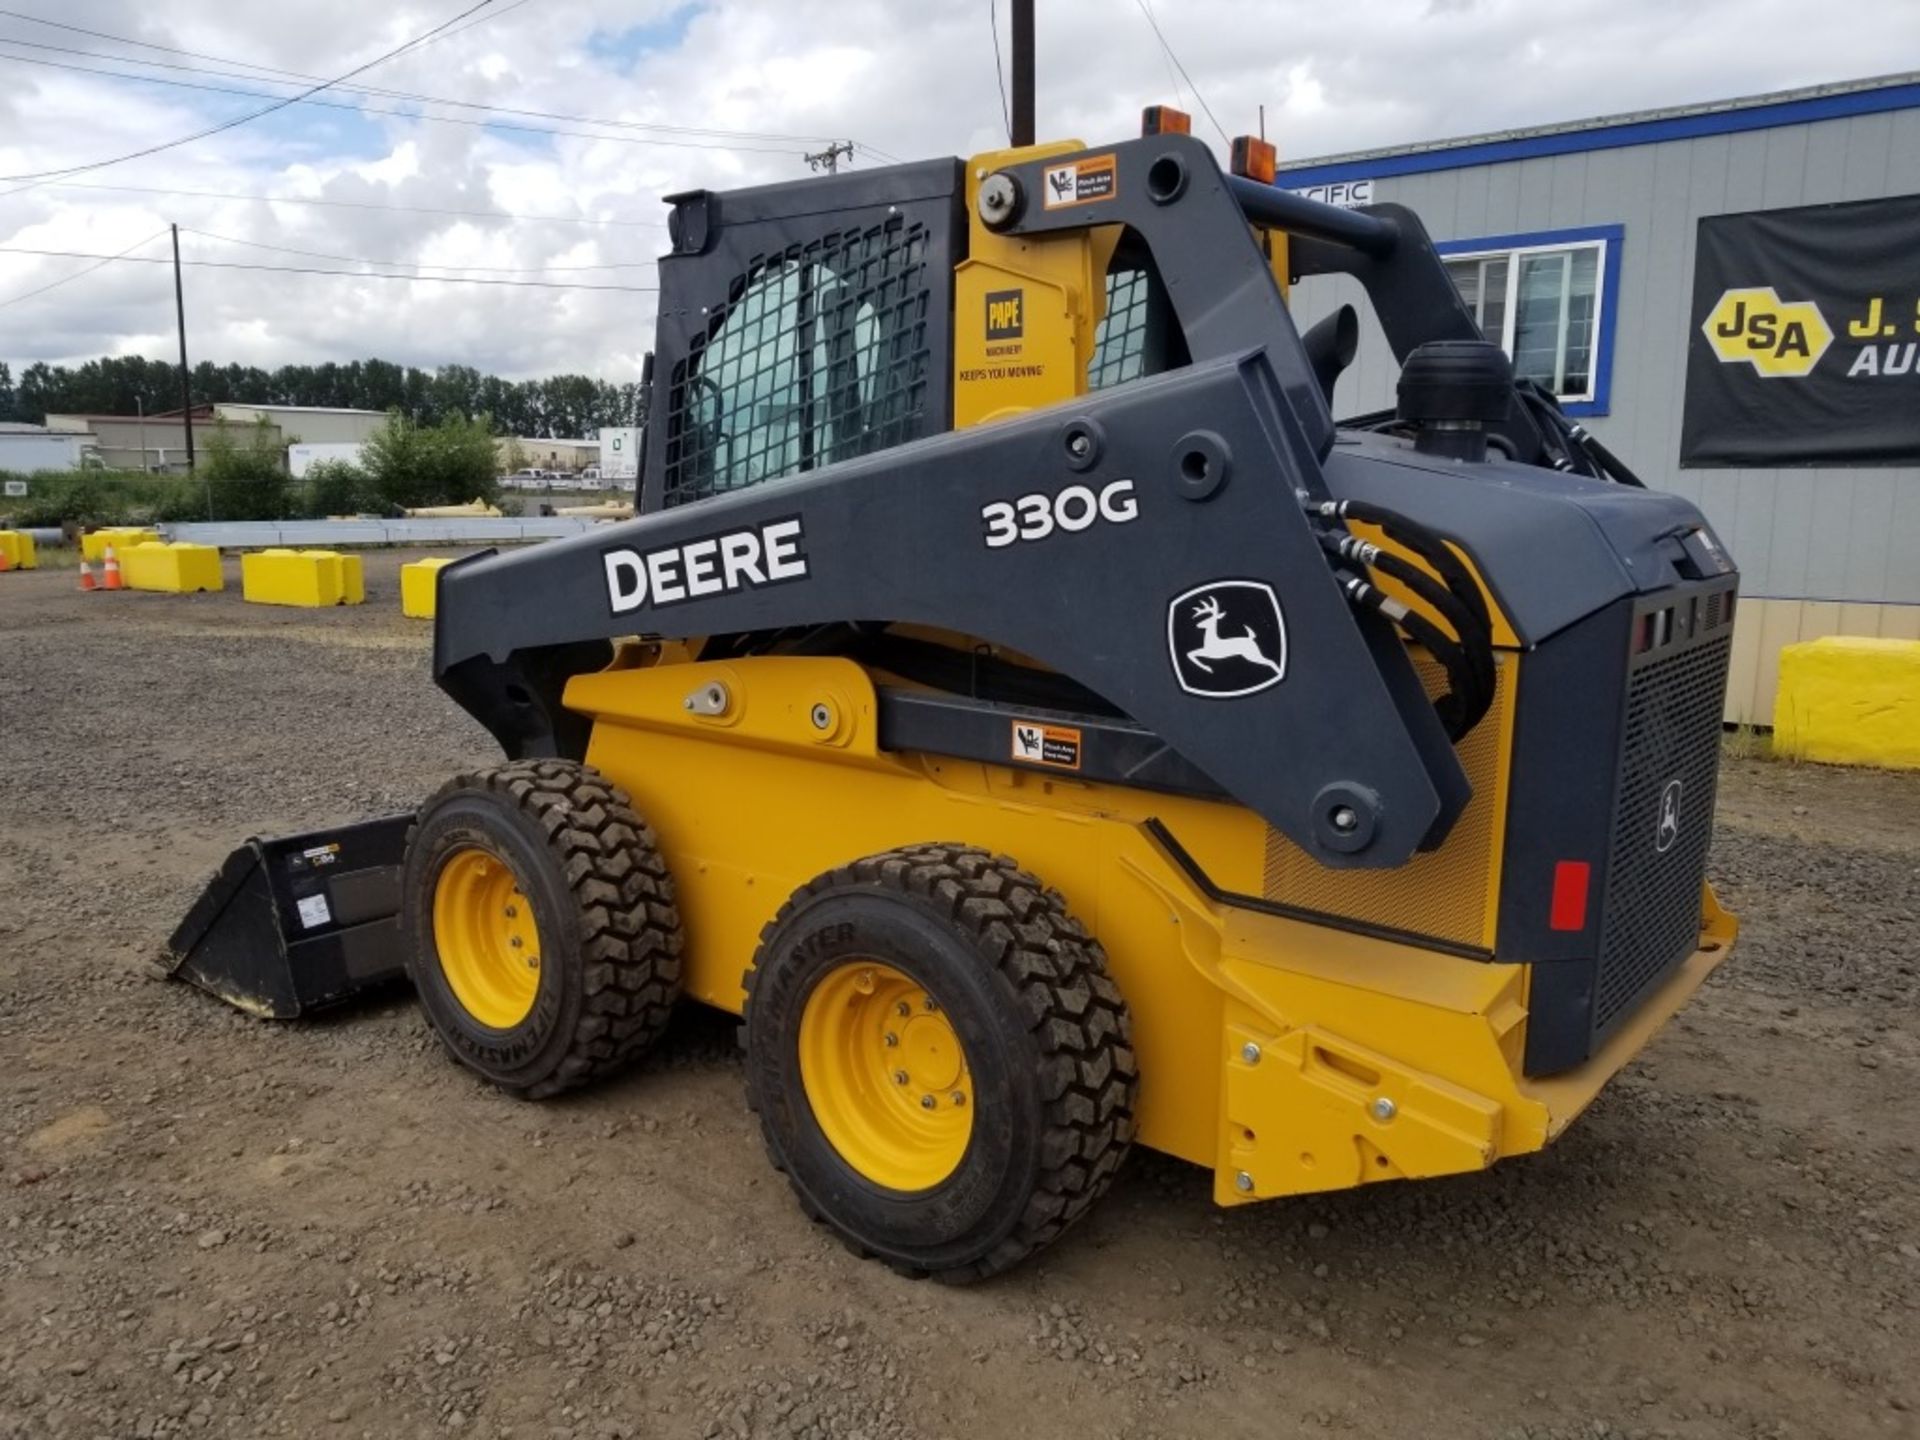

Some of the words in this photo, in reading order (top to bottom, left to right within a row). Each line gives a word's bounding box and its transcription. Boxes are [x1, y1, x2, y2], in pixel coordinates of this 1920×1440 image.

[1717, 302, 1811, 358] JSA
[960, 369, 987, 380] KEEPS
[988, 367, 1005, 379] YOU
[1847, 342, 1920, 377] AU
[982, 479, 1138, 547] 330G
[604, 519, 806, 612] DEERE
